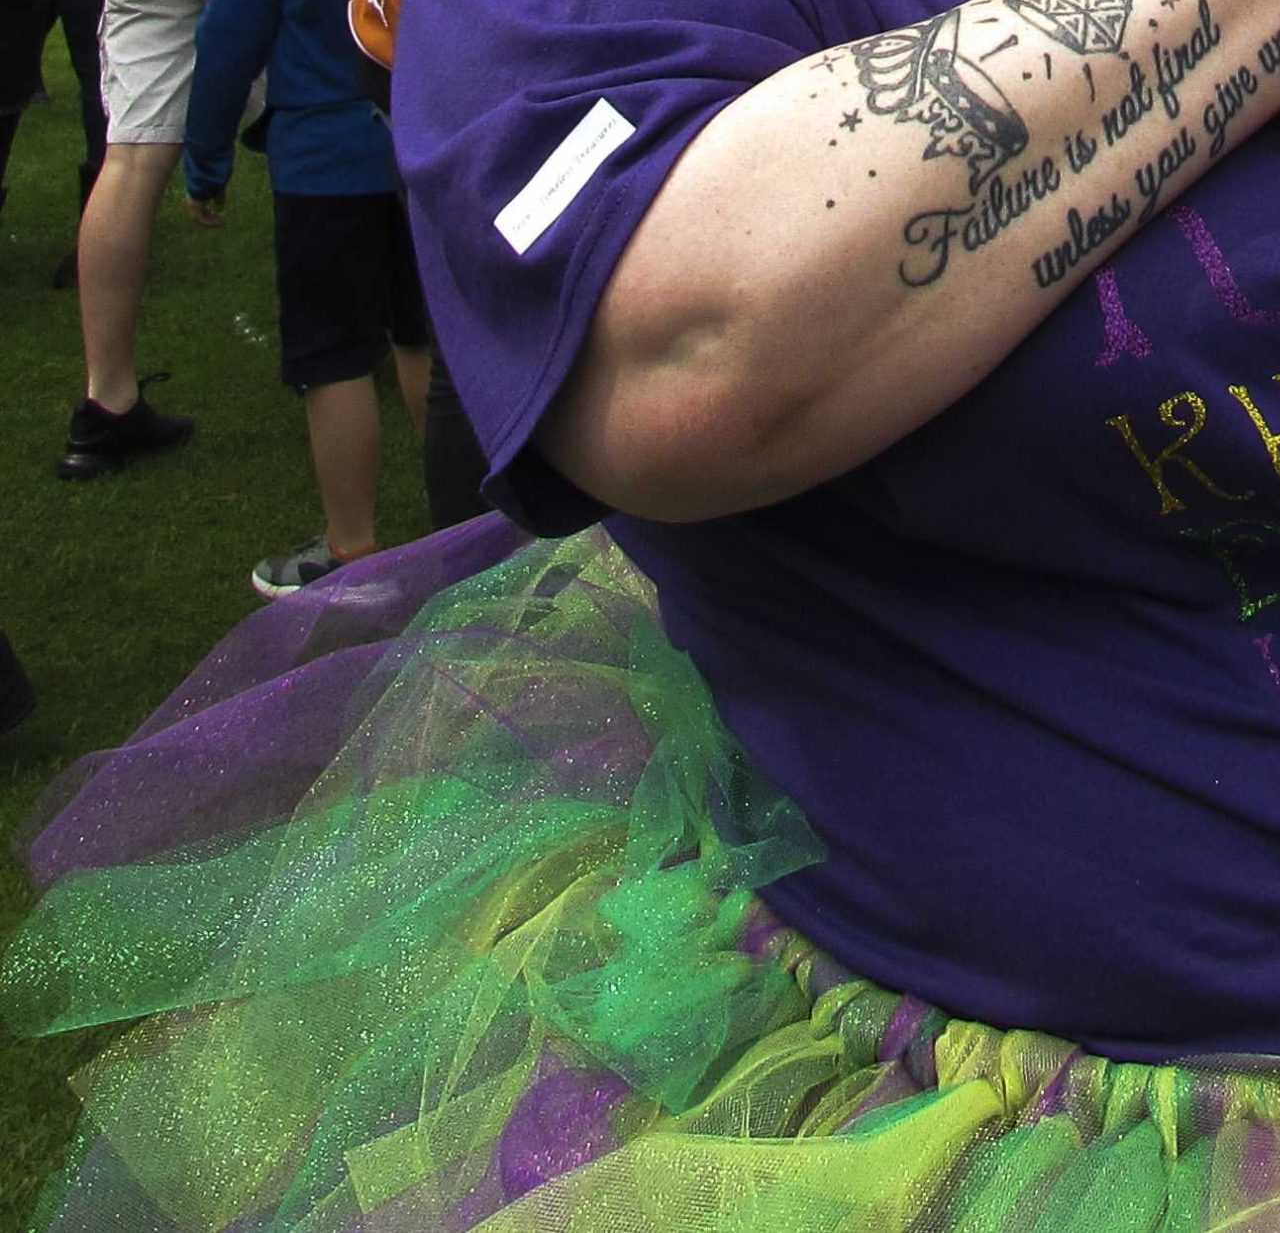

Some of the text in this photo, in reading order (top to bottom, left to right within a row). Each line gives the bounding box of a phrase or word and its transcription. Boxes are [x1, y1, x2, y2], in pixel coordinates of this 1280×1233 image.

[899, 156, 1062, 288] Failure
[1065, 129, 1098, 175] is
[1101, 62, 1153, 146] not
[1031, 193, 1131, 289] unless
[1134, 129, 1196, 223] you
[1202, 66, 1259, 157] give
